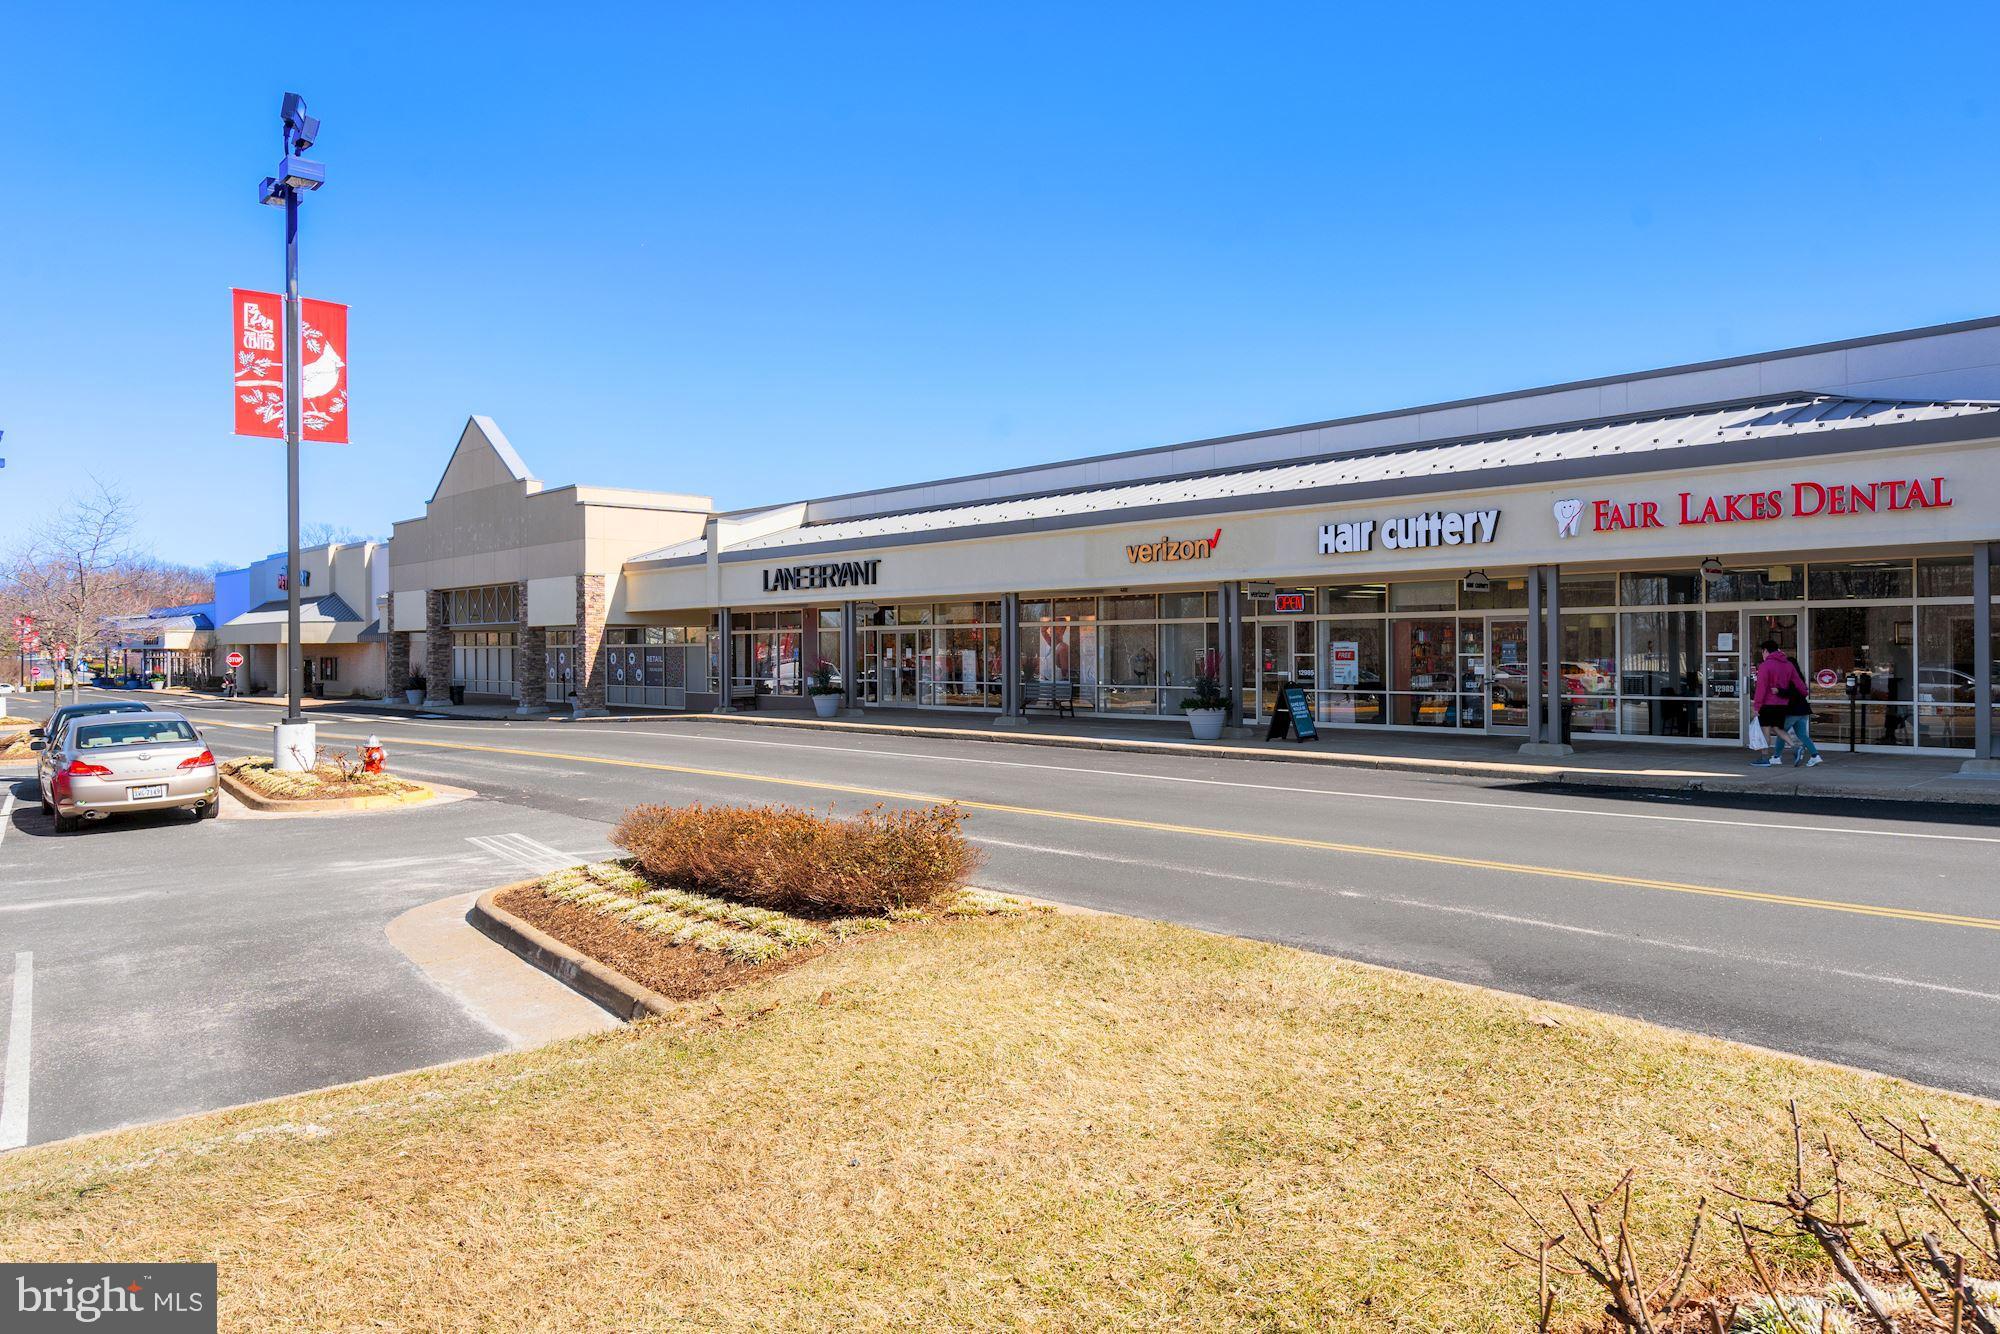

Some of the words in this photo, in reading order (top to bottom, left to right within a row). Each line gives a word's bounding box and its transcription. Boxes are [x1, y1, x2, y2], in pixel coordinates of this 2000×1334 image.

[1592, 498, 1665, 532] FAIR
[1678, 489, 1783, 526] LAKES
[1791, 476, 1953, 518] DENTAL
[1126, 536, 1210, 563] verizon
[1277, 596, 1303, 610] OPEN
[646, 655, 663, 663] RETAIL
